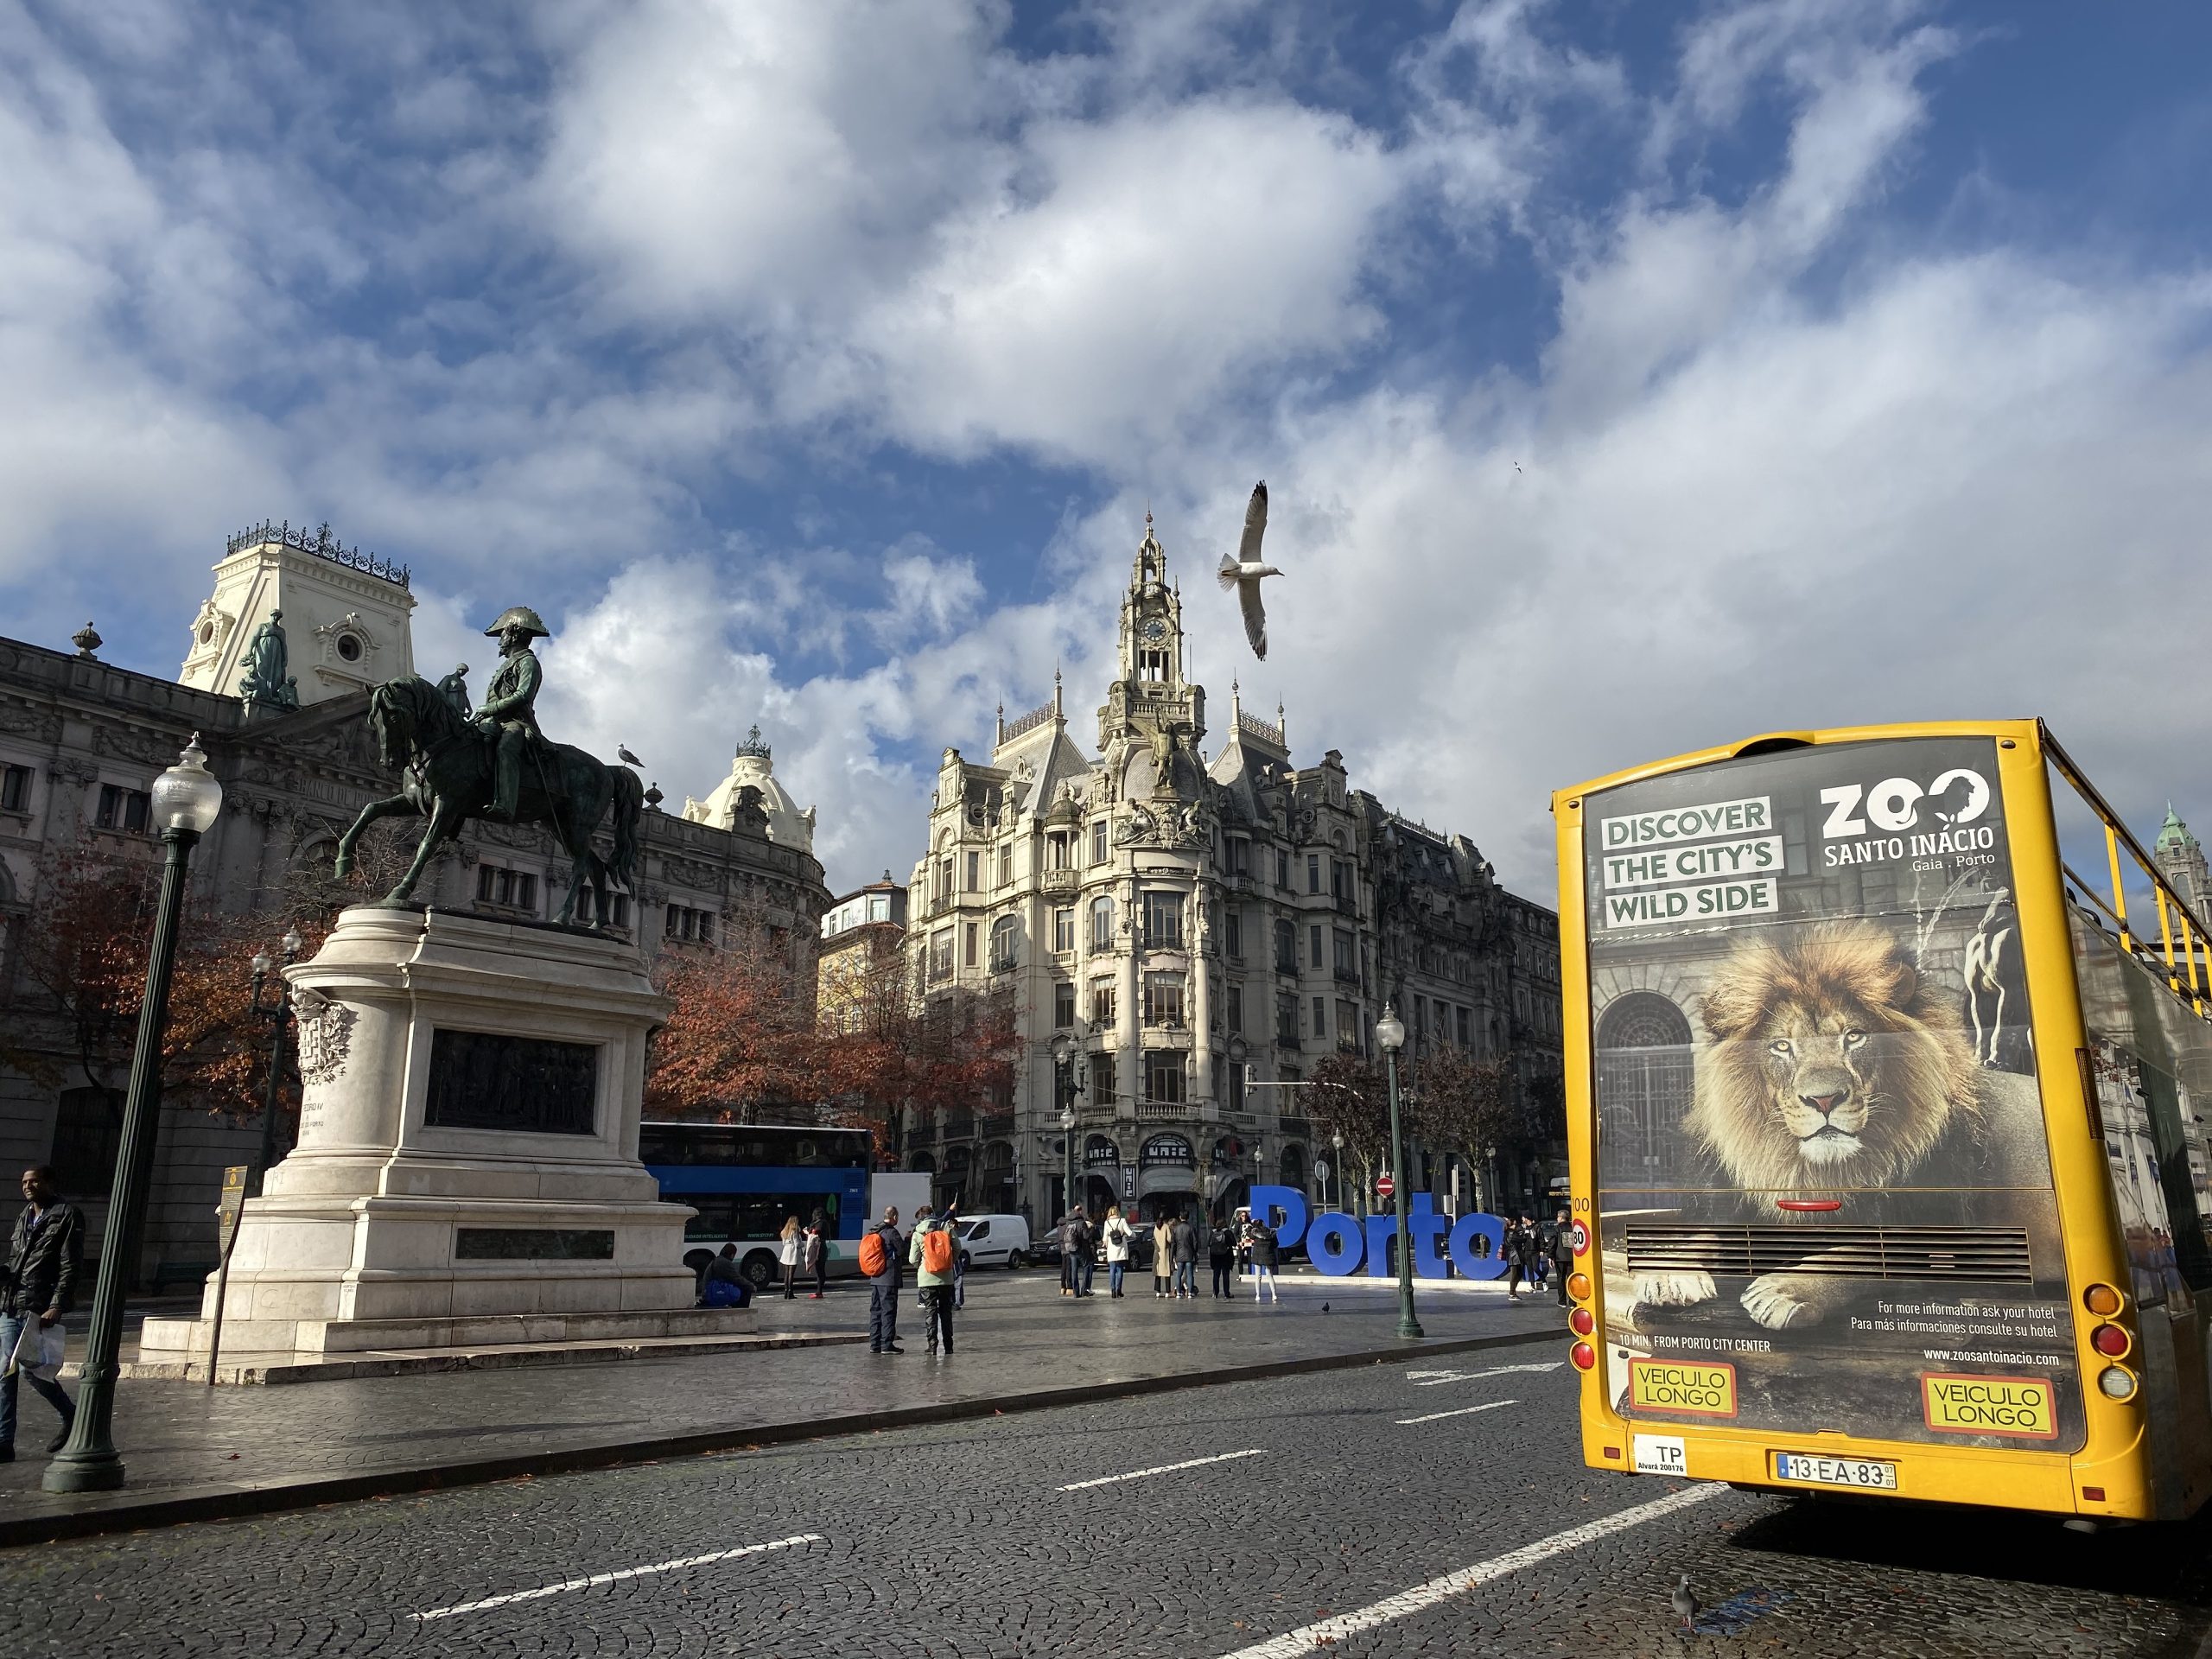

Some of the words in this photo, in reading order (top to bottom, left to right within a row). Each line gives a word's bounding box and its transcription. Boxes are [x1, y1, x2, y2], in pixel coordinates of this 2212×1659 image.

[1820, 768, 1990, 839] ZOO
[1608, 802, 1765, 845] DISCOVER
[1824, 837, 1904, 867] SANTO
[1910, 824, 1994, 857] INÁCIO
[1608, 854, 1668, 883] THE
[1676, 842, 1772, 875] CITY'S
[1912, 860, 1943, 872] Gaia
[1955, 853, 1995, 868] Porto
[1611, 892, 1688, 922] WILD
[1697, 882, 1770, 913] SIDE
[1878, 1300, 1893, 1313] For
[1896, 1304, 1920, 1314] more
[1923, 1302, 1980, 1316] information
[1982, 1305, 2001, 1318] ask
[2002, 1307, 2024, 1320] your
[2028, 1306, 2056, 1319] hotel
[1851, 1317, 1872, 1330] Para
[1874, 1318, 1895, 1331] más
[1897, 1319, 1966, 1333] informaciones
[1968, 1322, 2012, 1336] consulte
[2015, 1325, 2027, 1337] su
[2030, 1324, 2058, 1338] hotel
[1619, 1334, 1630, 1345] 10
[1631, 1334, 1652, 1347] MIN.
[1654, 1335, 1679, 1348] FROM
[1681, 1337, 1711, 1350] PORTO
[1713, 1338, 1732, 1351] CITY
[1735, 1339, 1771, 1353] CENTER
[1923, 1349, 2060, 1366] www.zoosantoinacio.com
[1638, 1367, 1726, 1389] VEICULO
[1645, 1385, 1721, 1407] LONGO
[1934, 1383, 2041, 1407] VEICULO
[1943, 1404, 2037, 1427] LONGO
[1656, 1446, 1681, 1463] TP
[1638, 1462, 1658, 1471] Alvará
[1660, 1464, 1684, 1472] 200176
